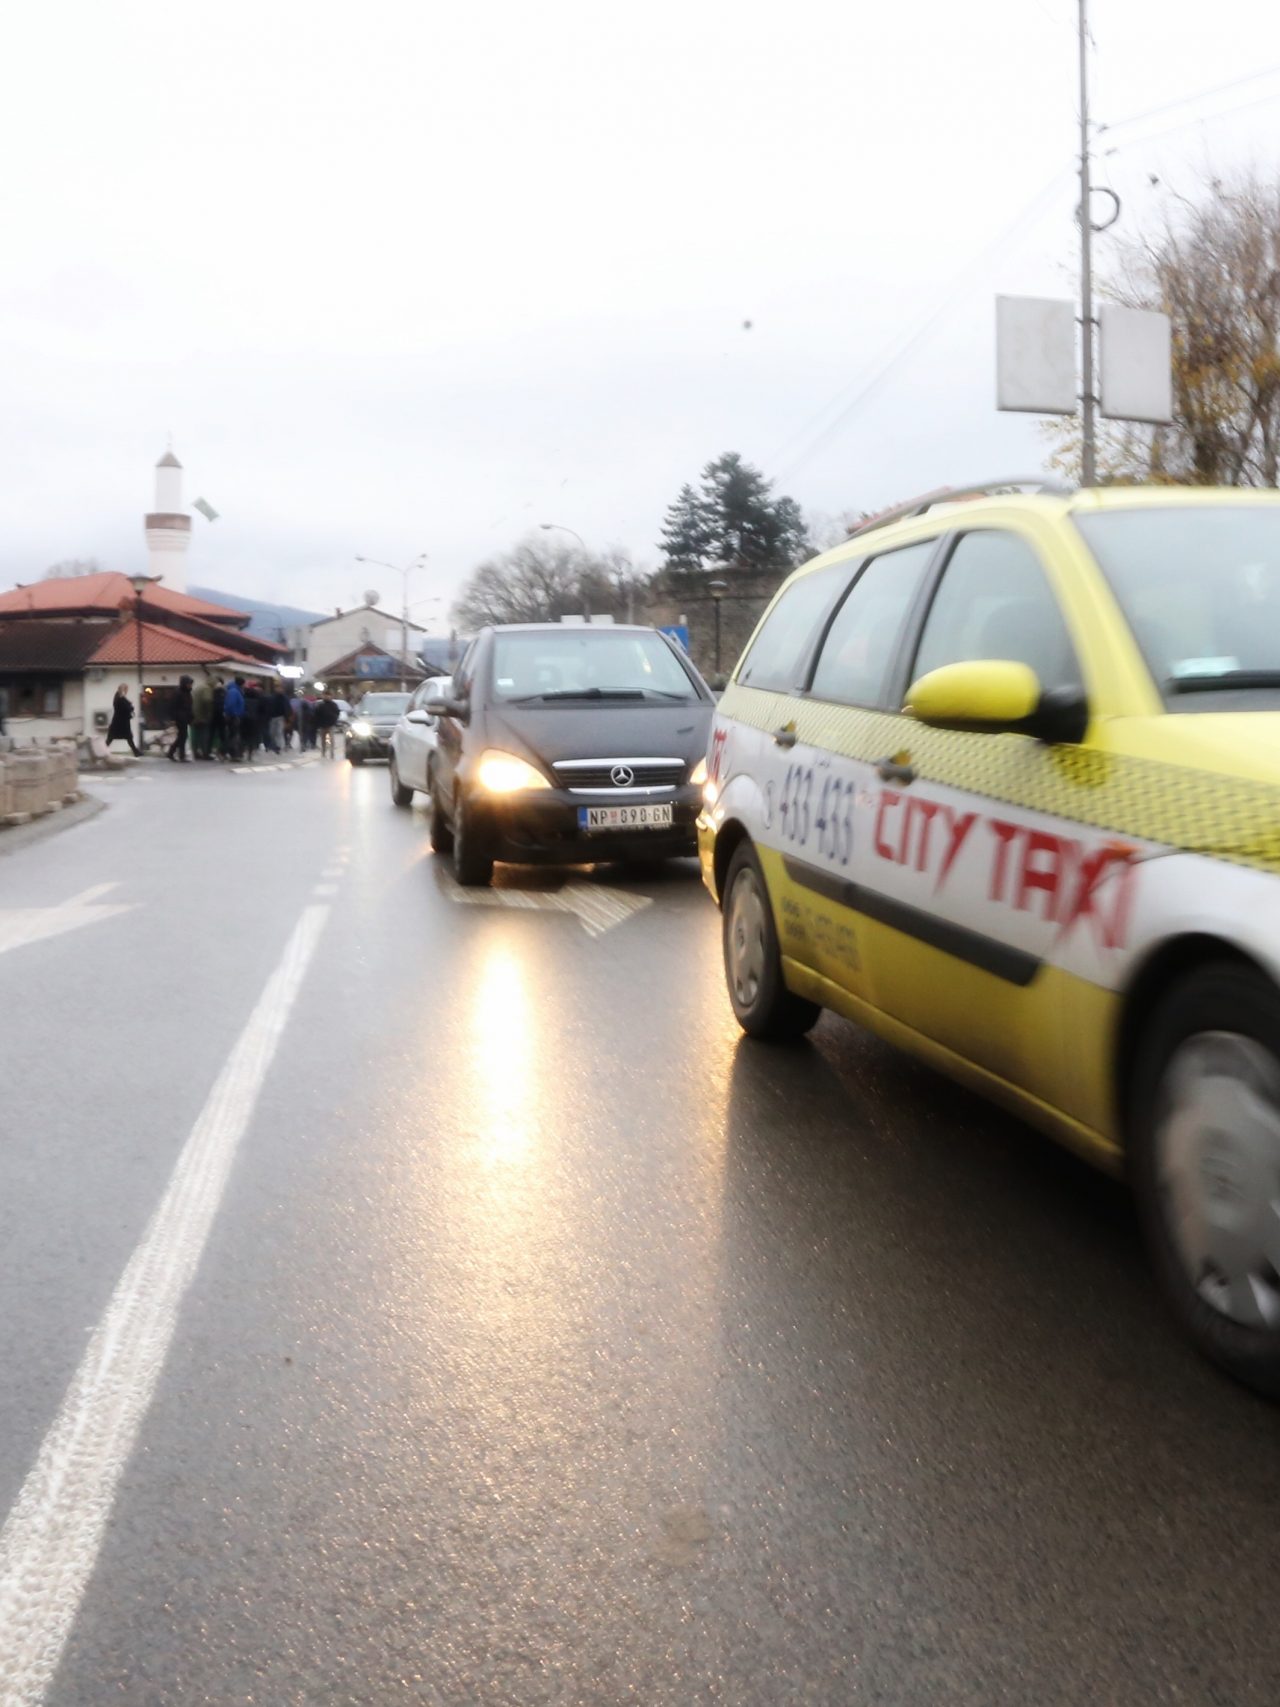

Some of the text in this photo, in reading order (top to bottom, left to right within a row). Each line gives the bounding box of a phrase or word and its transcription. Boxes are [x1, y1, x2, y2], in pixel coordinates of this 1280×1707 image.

[780, 763, 813, 846] 433
[874, 789, 979, 895] CITY
[987, 818, 1139, 953] TAXI
